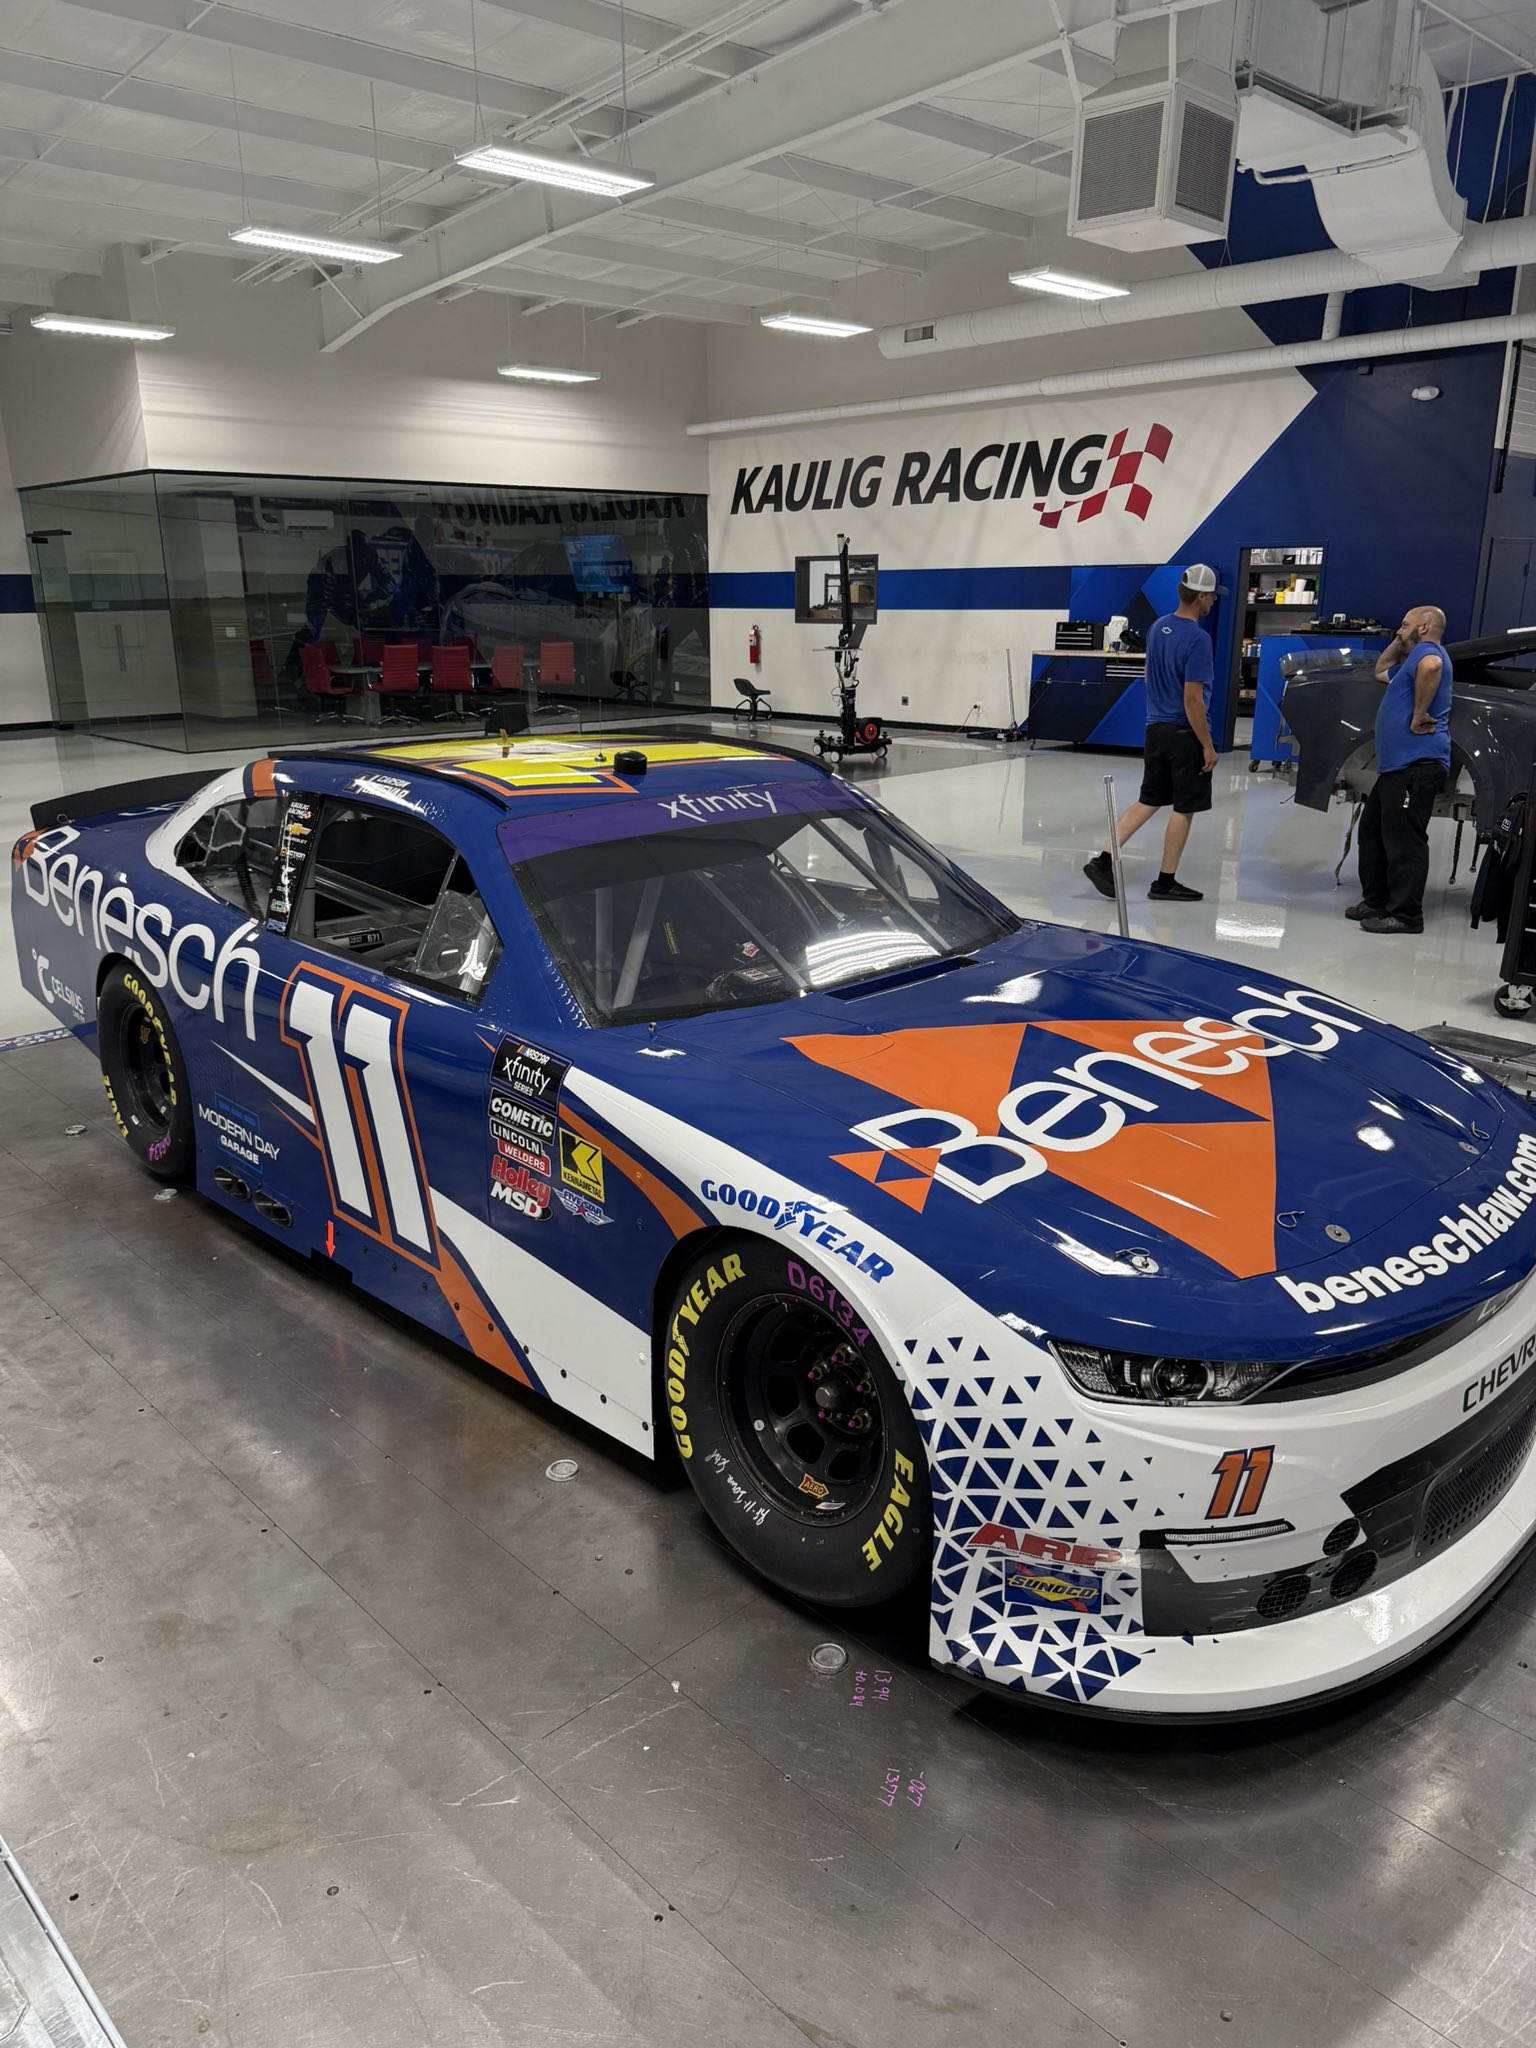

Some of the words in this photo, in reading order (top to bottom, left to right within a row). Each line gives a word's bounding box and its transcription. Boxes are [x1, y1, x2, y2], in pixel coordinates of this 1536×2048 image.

[730, 455, 885, 515] KAULIG
[892, 434, 1108, 507] RACING
[657, 788, 778, 822] xfinity
[22, 825, 260, 1042] Benesch
[51, 976, 85, 1015] CELSIUS
[124, 973, 177, 1106] GOODYEAR
[523, 1046, 550, 1066] NASCAR
[502, 1056, 550, 1096] xfinity
[513, 1081, 534, 1097] SERIES
[848, 985, 1388, 1205] Benesch
[198, 1103, 252, 1146] MODERN
[254, 1134, 280, 1160] DAY
[289, 979, 432, 1254] 11
[491, 1097, 554, 1138] COMETIC
[493, 1123, 540, 1155] LINCOLN
[220, 1134, 259, 1165] GARAGE
[504, 1143, 546, 1172] WELDERS
[490, 1181, 542, 1219] MSD
[491, 1155, 551, 1208] Holley
[701, 1179, 895, 1284] GOODYEAR
[1275, 1133, 1536, 1314] beneschlaw.com
[787, 1259, 870, 1347] D6134
[667, 1253, 747, 1459] GOODYEAR
[1463, 1333, 1536, 1413] CHEVR
[804, 1481, 824, 1494] AERO
[1204, 1444, 1275, 1520] 11
[861, 1448, 914, 1571] EAGLE
[968, 1521, 1122, 1567] ARP
[1010, 1574, 1096, 1598] SUNOCO
[878, 1767, 900, 1808] 13.77
